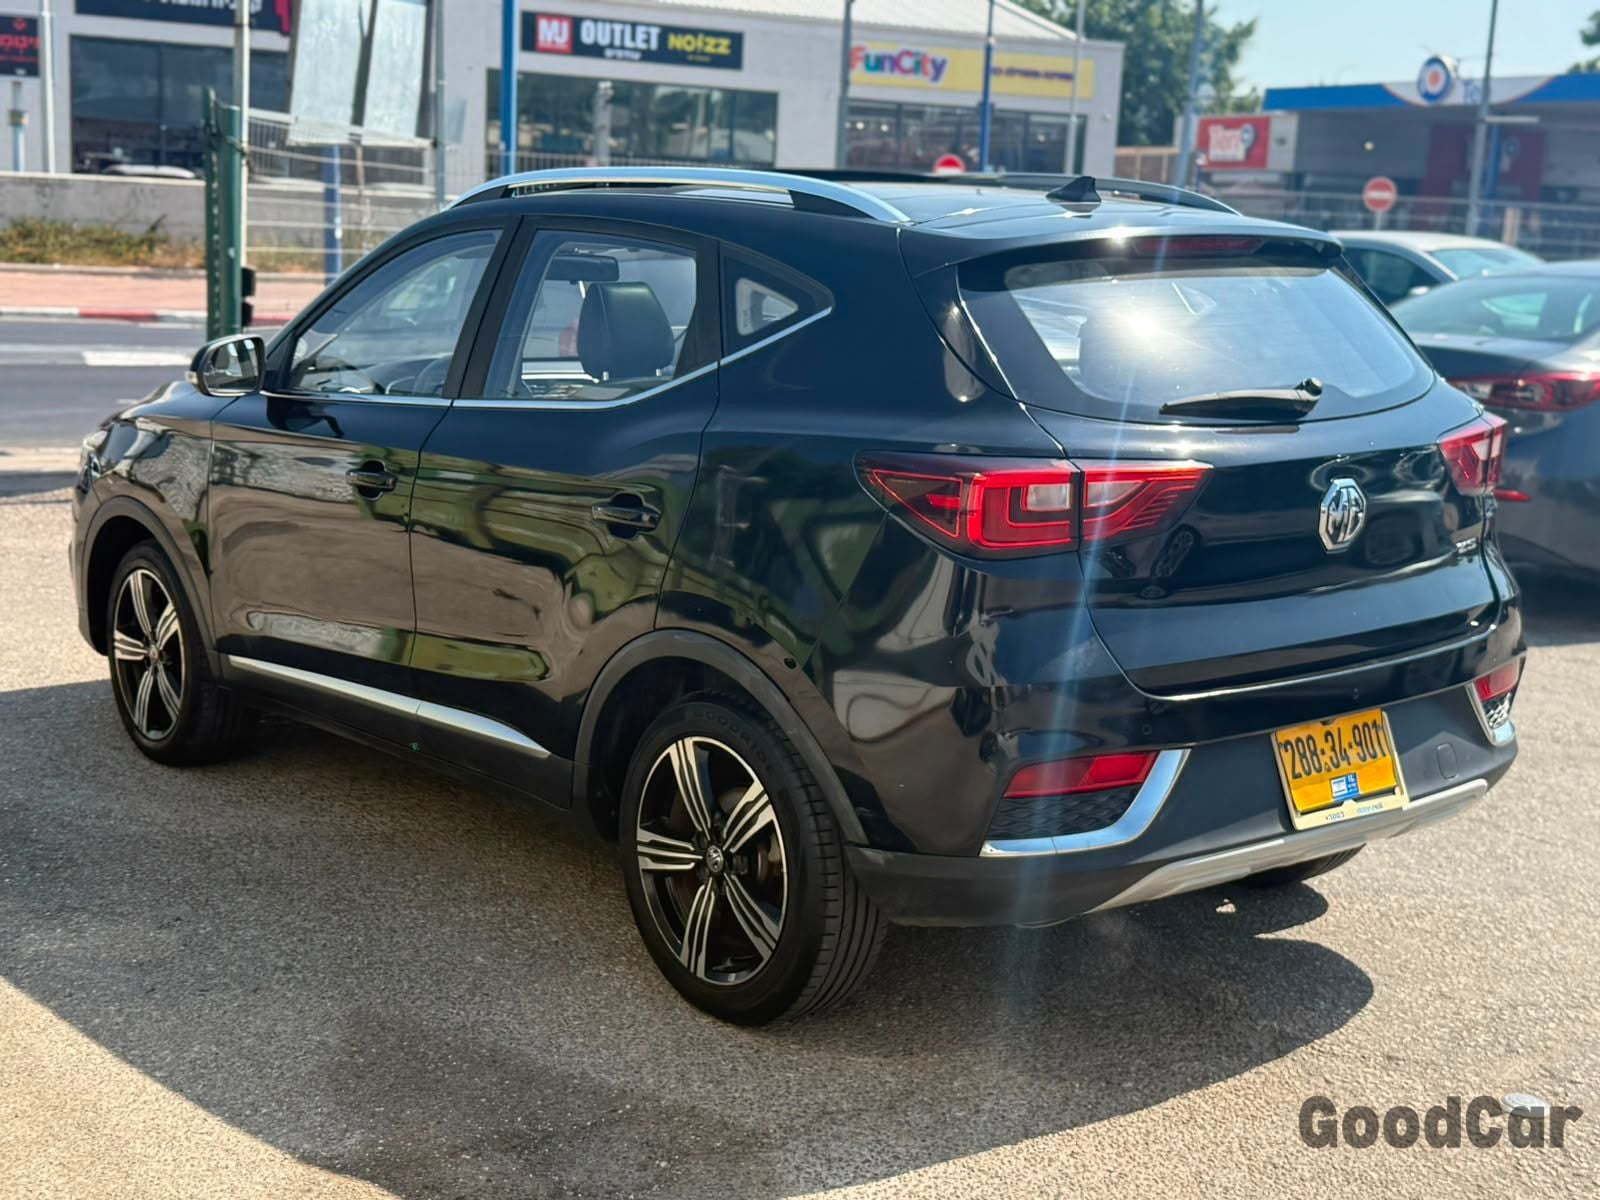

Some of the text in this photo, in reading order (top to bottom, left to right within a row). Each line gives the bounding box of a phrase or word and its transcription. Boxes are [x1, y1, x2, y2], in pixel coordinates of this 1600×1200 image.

[537, 18, 569, 46] MJ
[580, 19, 661, 50] OUTLET
[849, 44, 948, 83] FunCity
[1324, 485, 1364, 546] MG
